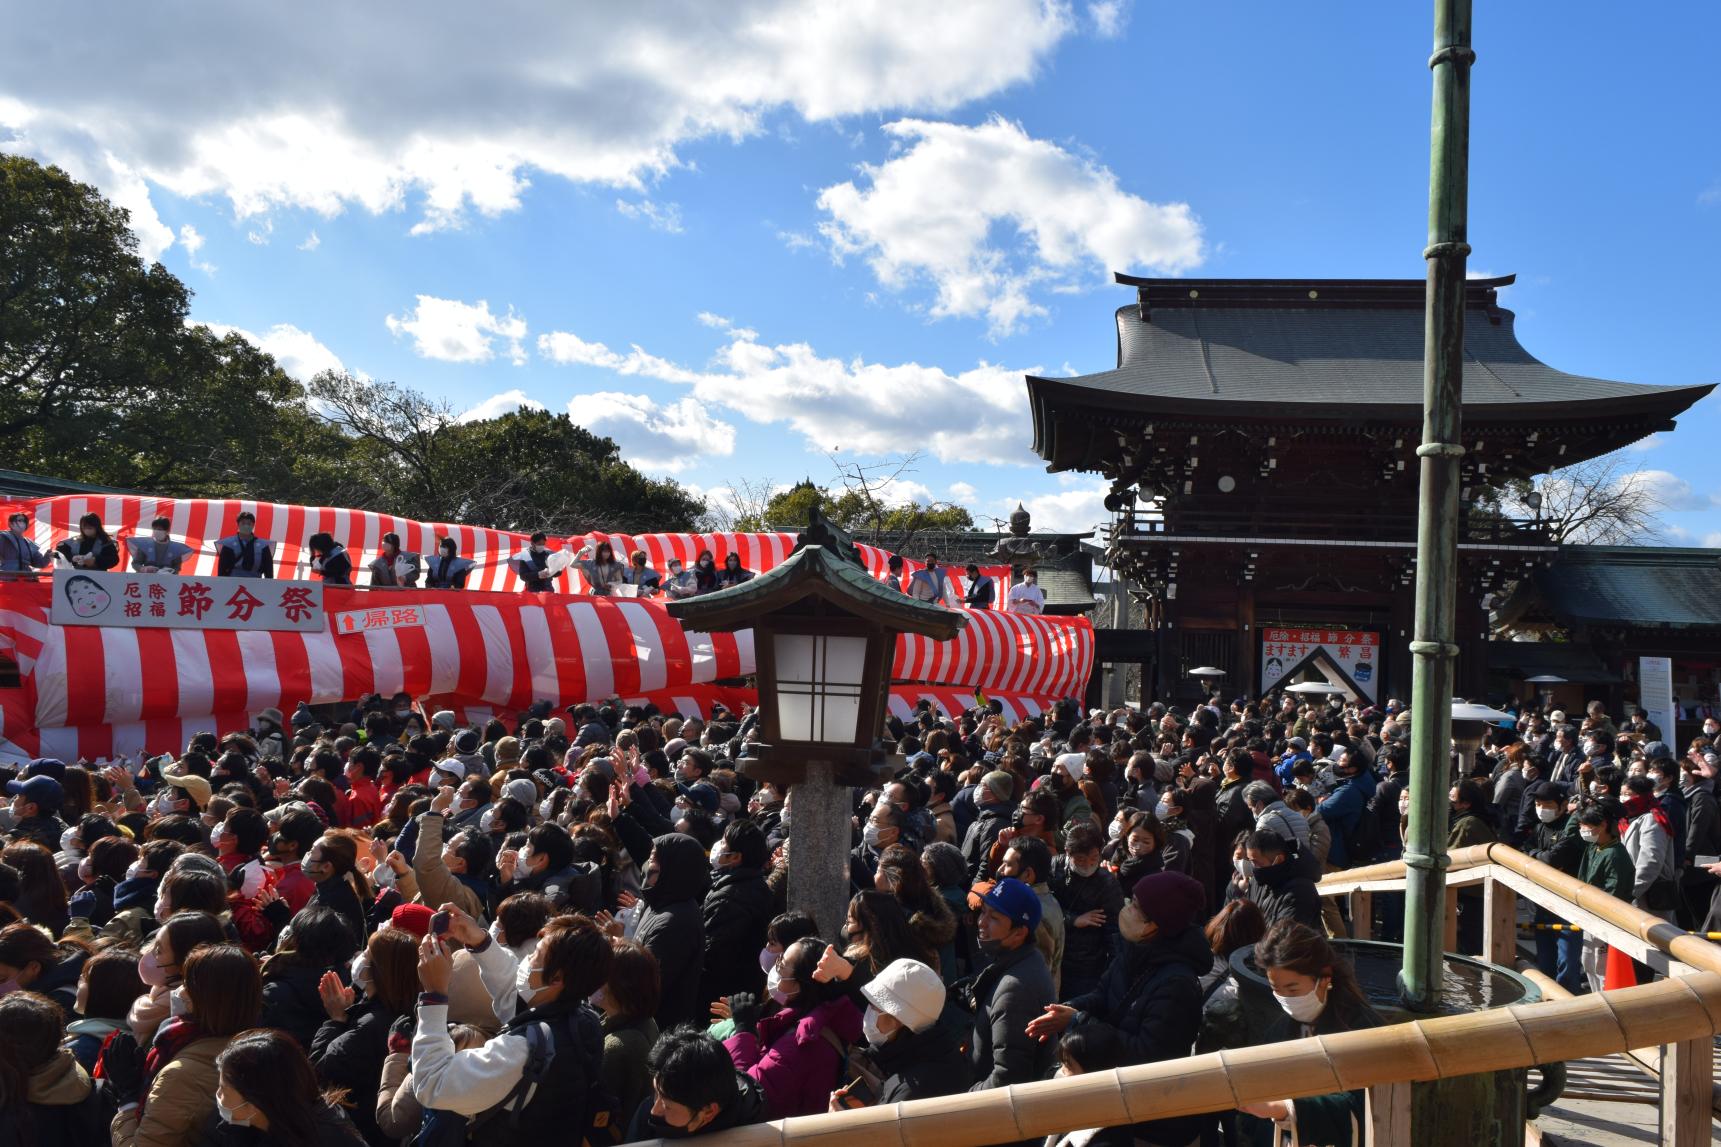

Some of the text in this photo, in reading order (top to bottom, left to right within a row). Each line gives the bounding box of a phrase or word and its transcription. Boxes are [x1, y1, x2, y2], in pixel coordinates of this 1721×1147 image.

[124, 582, 167, 599] 厄除
[124, 600, 167, 617] 招福
[177, 582, 317, 622] 節分祭
[362, 608, 419, 628] 帰路
[1266, 644, 1308, 657] ますます
